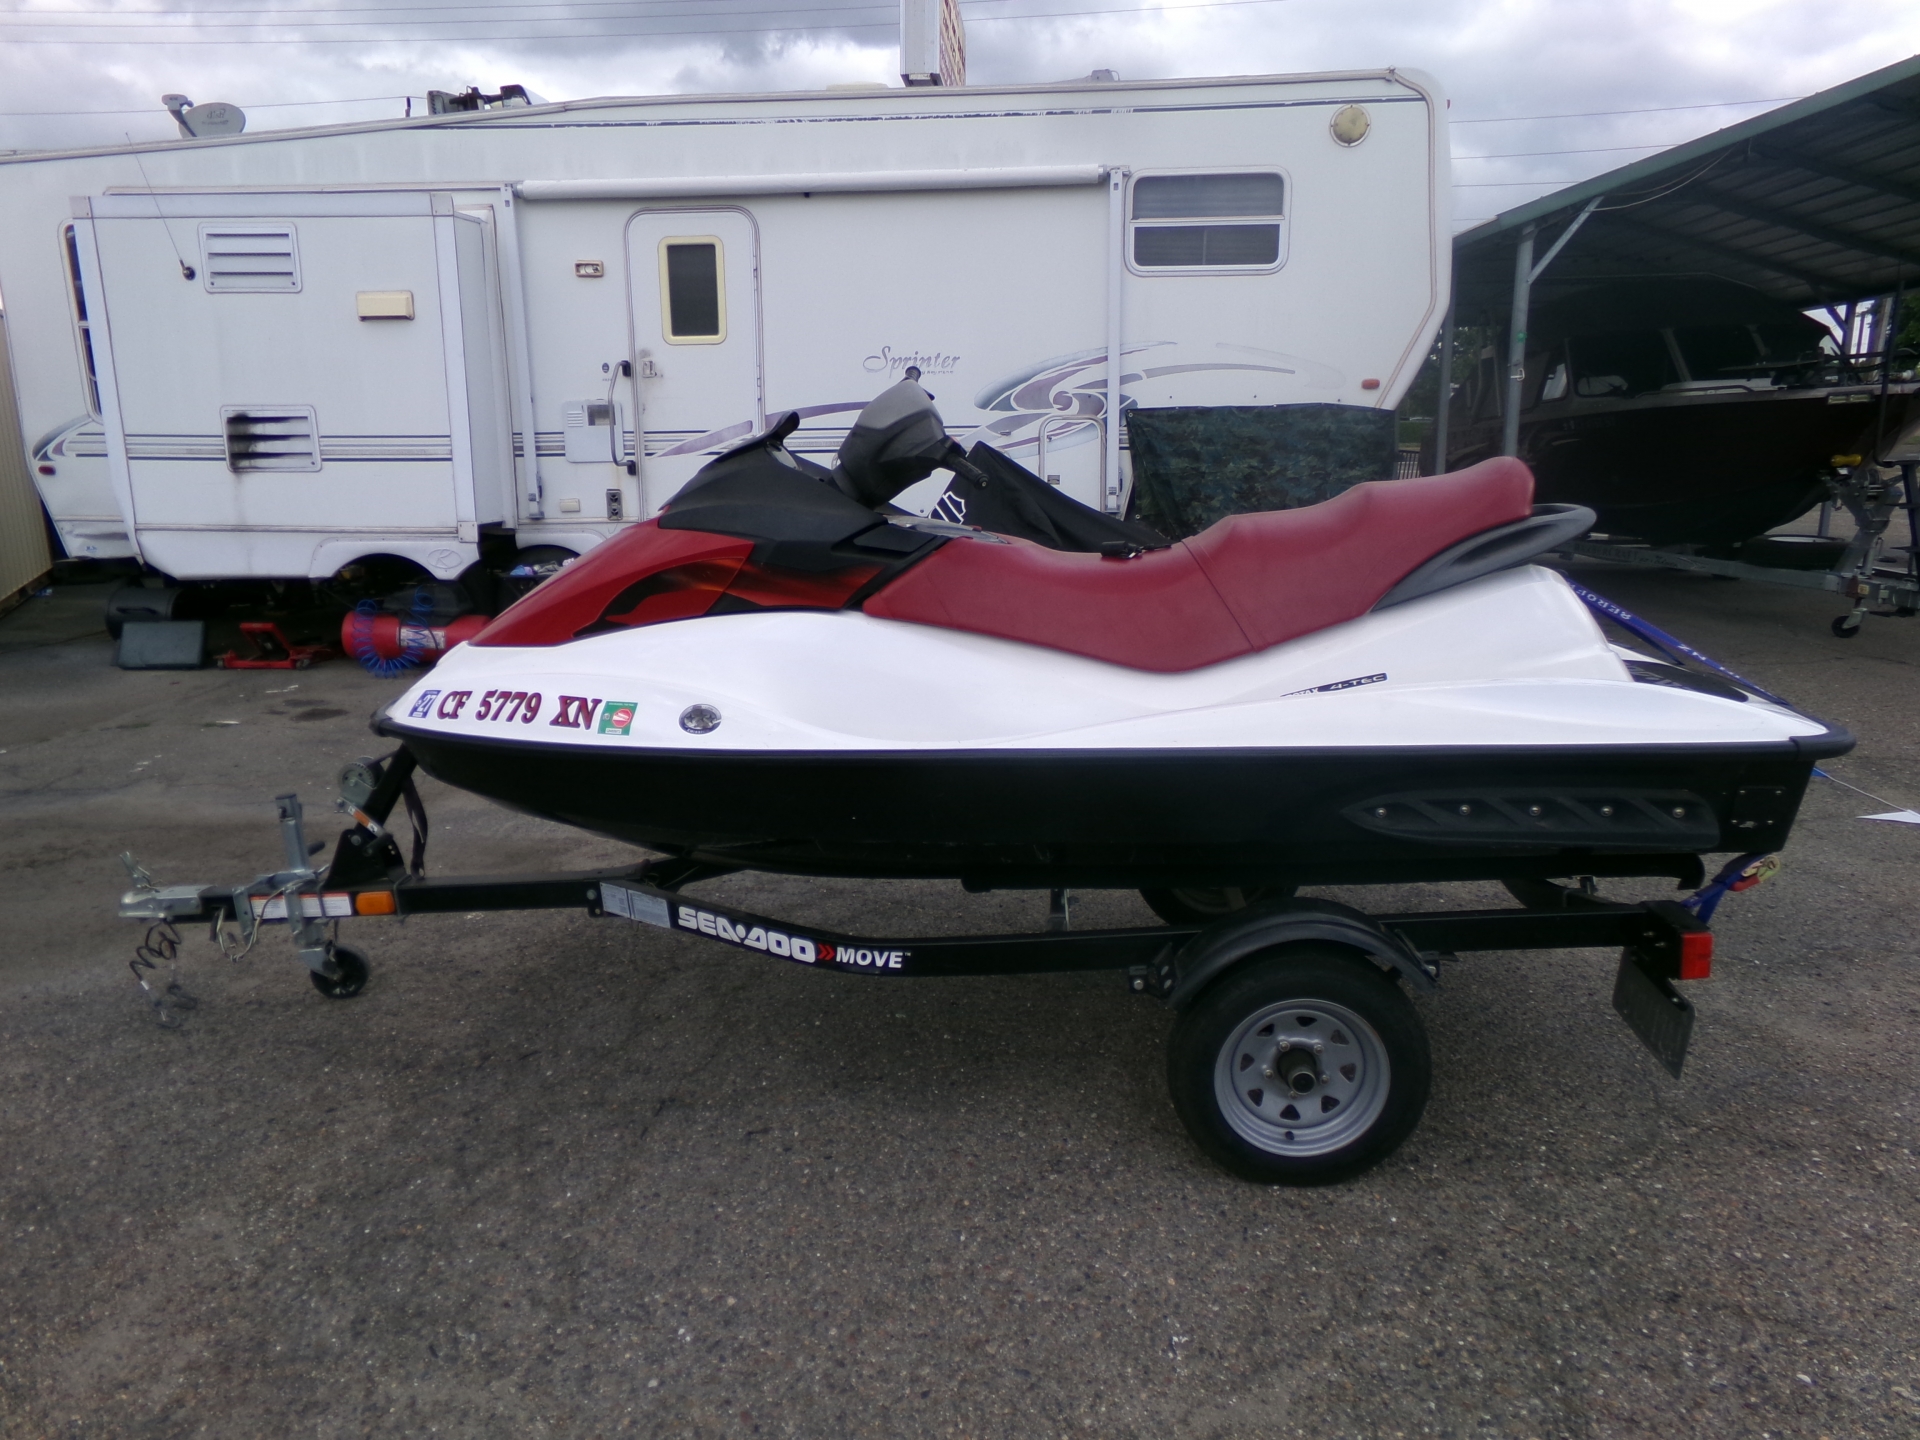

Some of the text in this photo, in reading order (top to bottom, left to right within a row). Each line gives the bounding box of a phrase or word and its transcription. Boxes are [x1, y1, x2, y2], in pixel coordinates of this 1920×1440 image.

[862, 345, 960, 379] Sprinter
[416, 696, 437, 713] 27
[437, 689, 602, 730] CF 5779 XN
